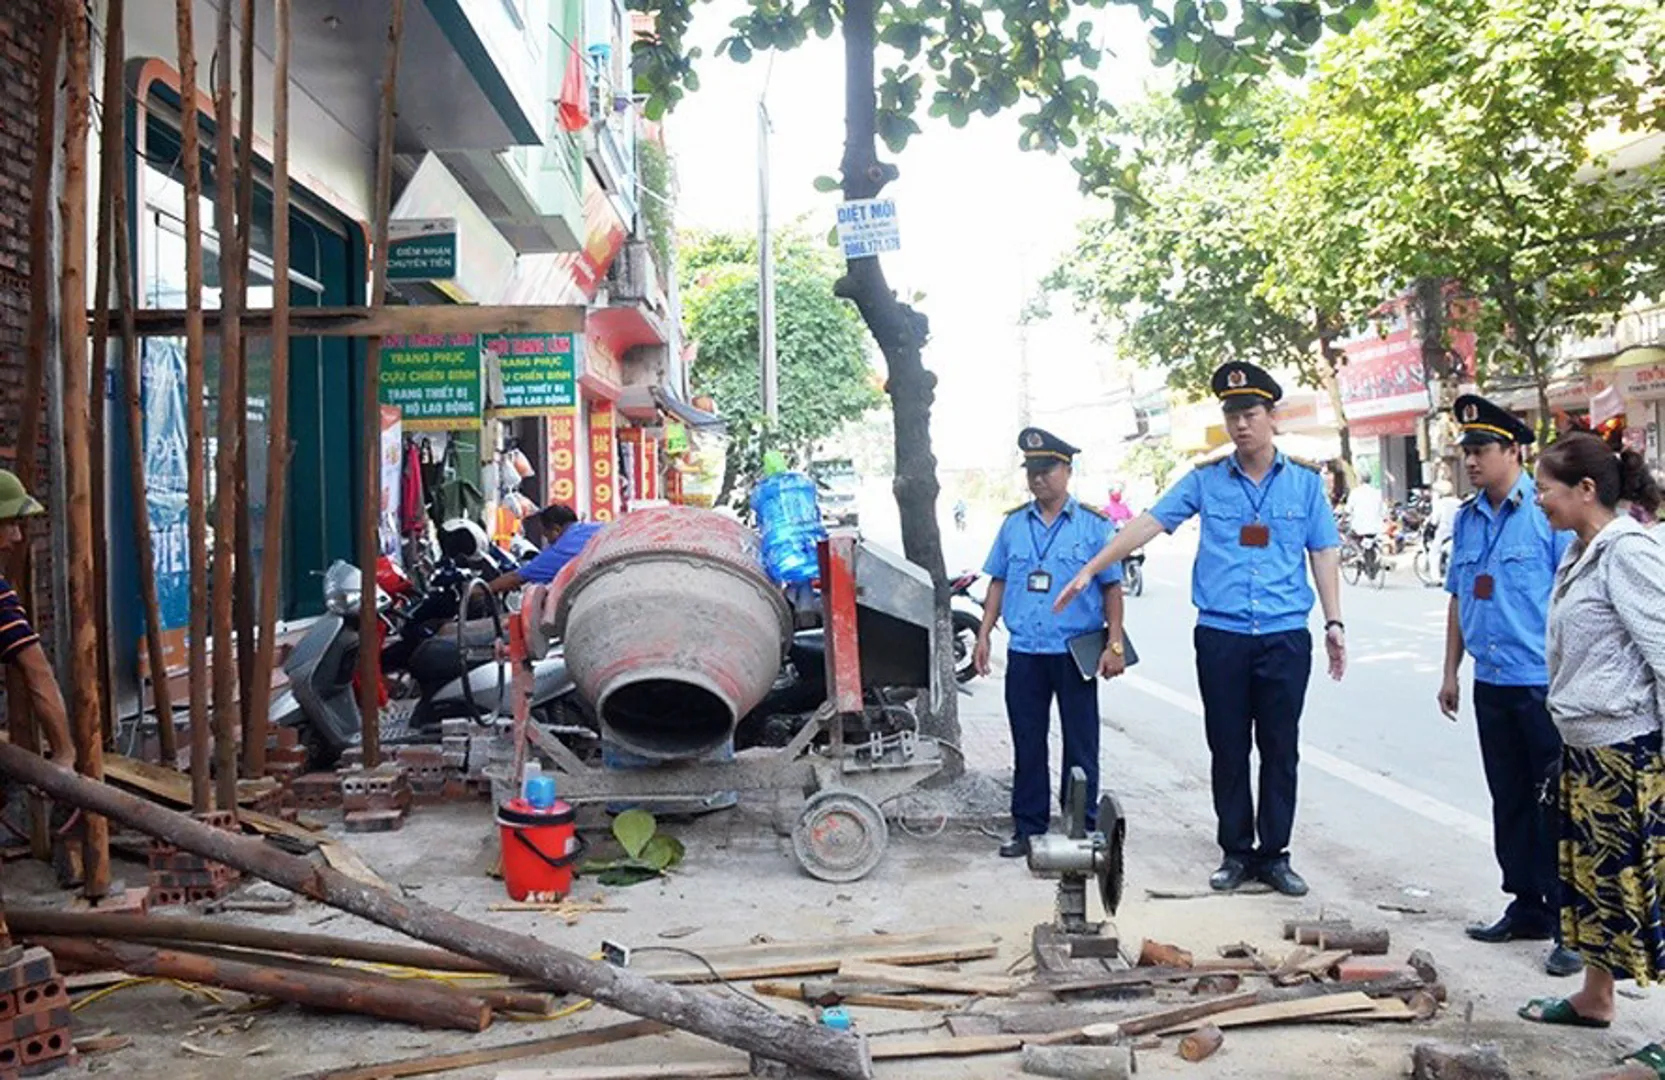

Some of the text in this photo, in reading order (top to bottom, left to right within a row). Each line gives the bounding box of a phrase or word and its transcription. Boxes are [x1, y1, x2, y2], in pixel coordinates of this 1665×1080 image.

[390, 352, 466, 365] TRANG PHỤC
[388, 388, 422, 399] TRANG
[525, 396, 542, 404] LAO
[422, 402, 442, 413] LAO
